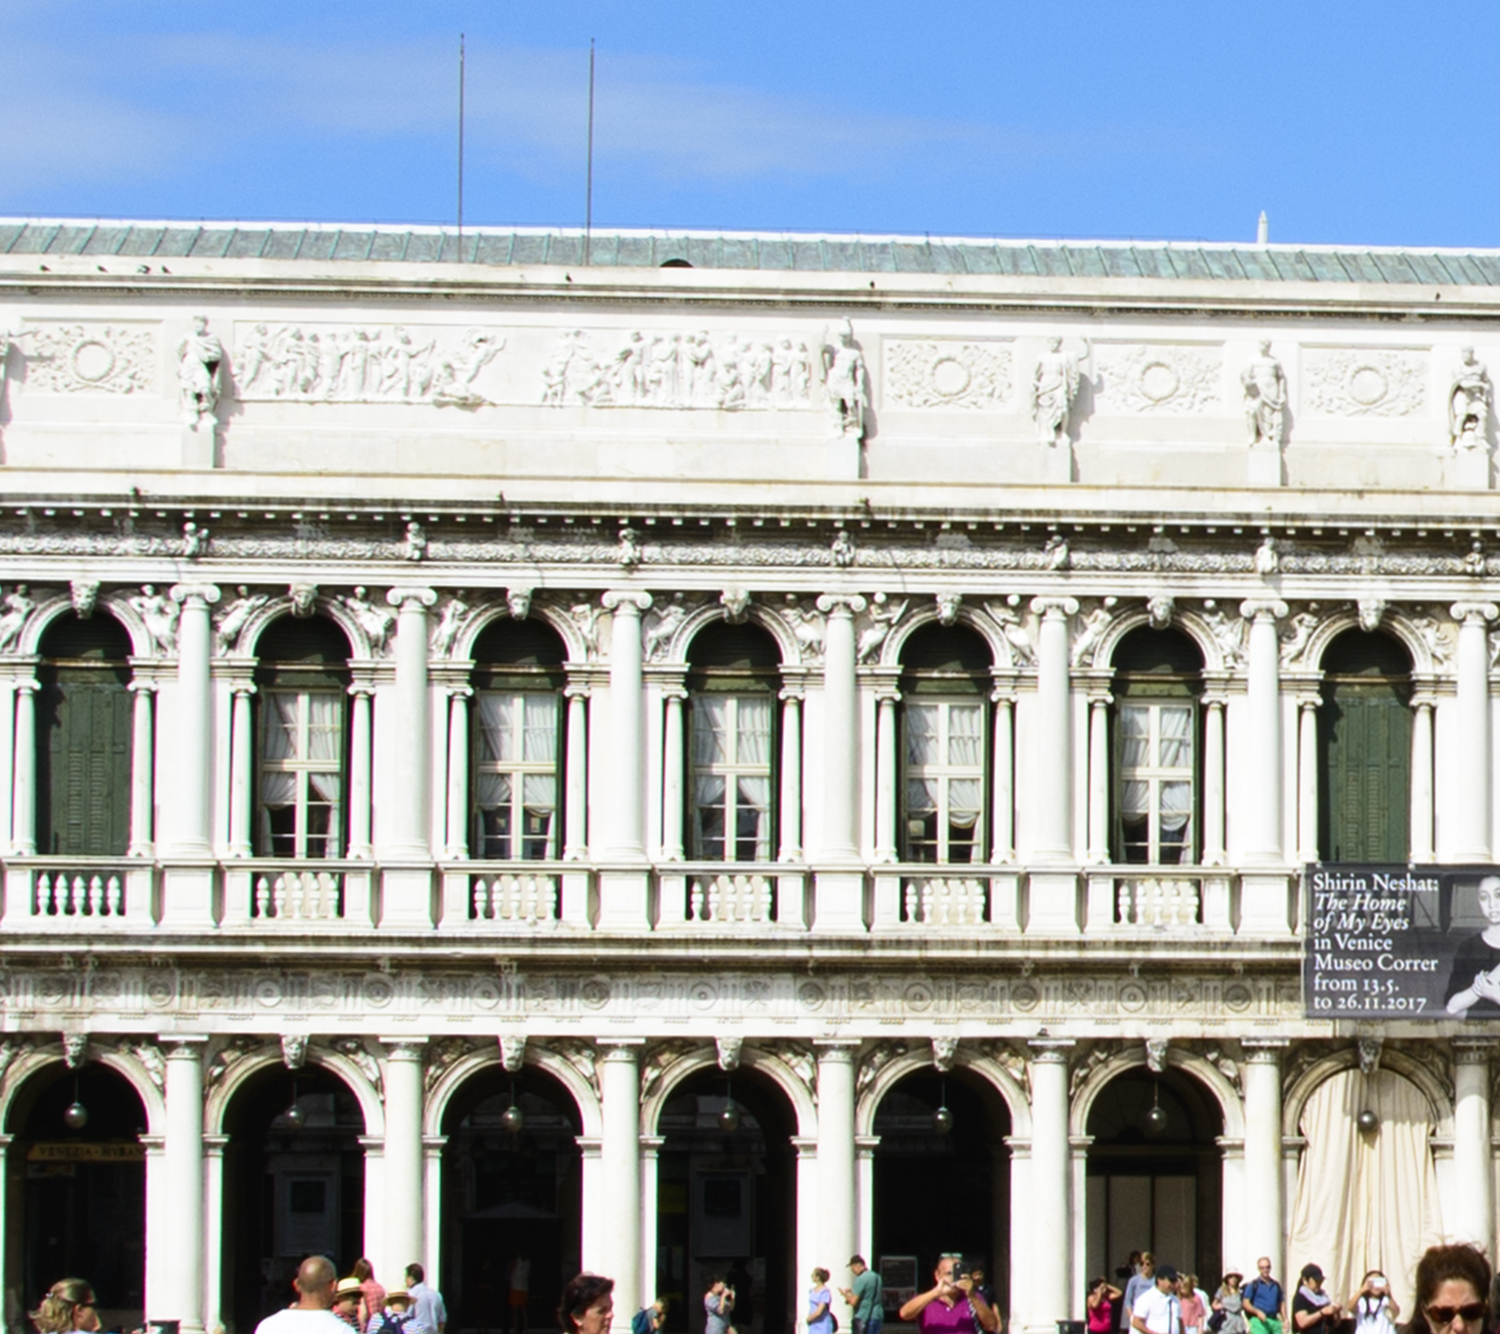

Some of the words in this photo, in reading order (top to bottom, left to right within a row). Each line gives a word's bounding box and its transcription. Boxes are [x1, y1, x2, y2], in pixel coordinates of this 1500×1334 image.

[1313, 872, 1367, 891] Shirin
[1372, 872, 1439, 892] Neshat:
[1315, 892, 1348, 911] The
[1352, 892, 1407, 911] Home
[1313, 911, 1335, 934] of
[1337, 912, 1366, 935] My
[1371, 912, 1410, 935] Eyes
[1314, 932, 1332, 950] in
[1334, 932, 1393, 950] Venice
[1314, 952, 1374, 971] Museo
[1377, 952, 1439, 971] Correr
[1313, 972, 1358, 991] from
[1363, 978, 1400, 995] 13.5.
[1314, 995, 1333, 1009] to
[1337, 993, 1427, 1014] 26.11.2017
